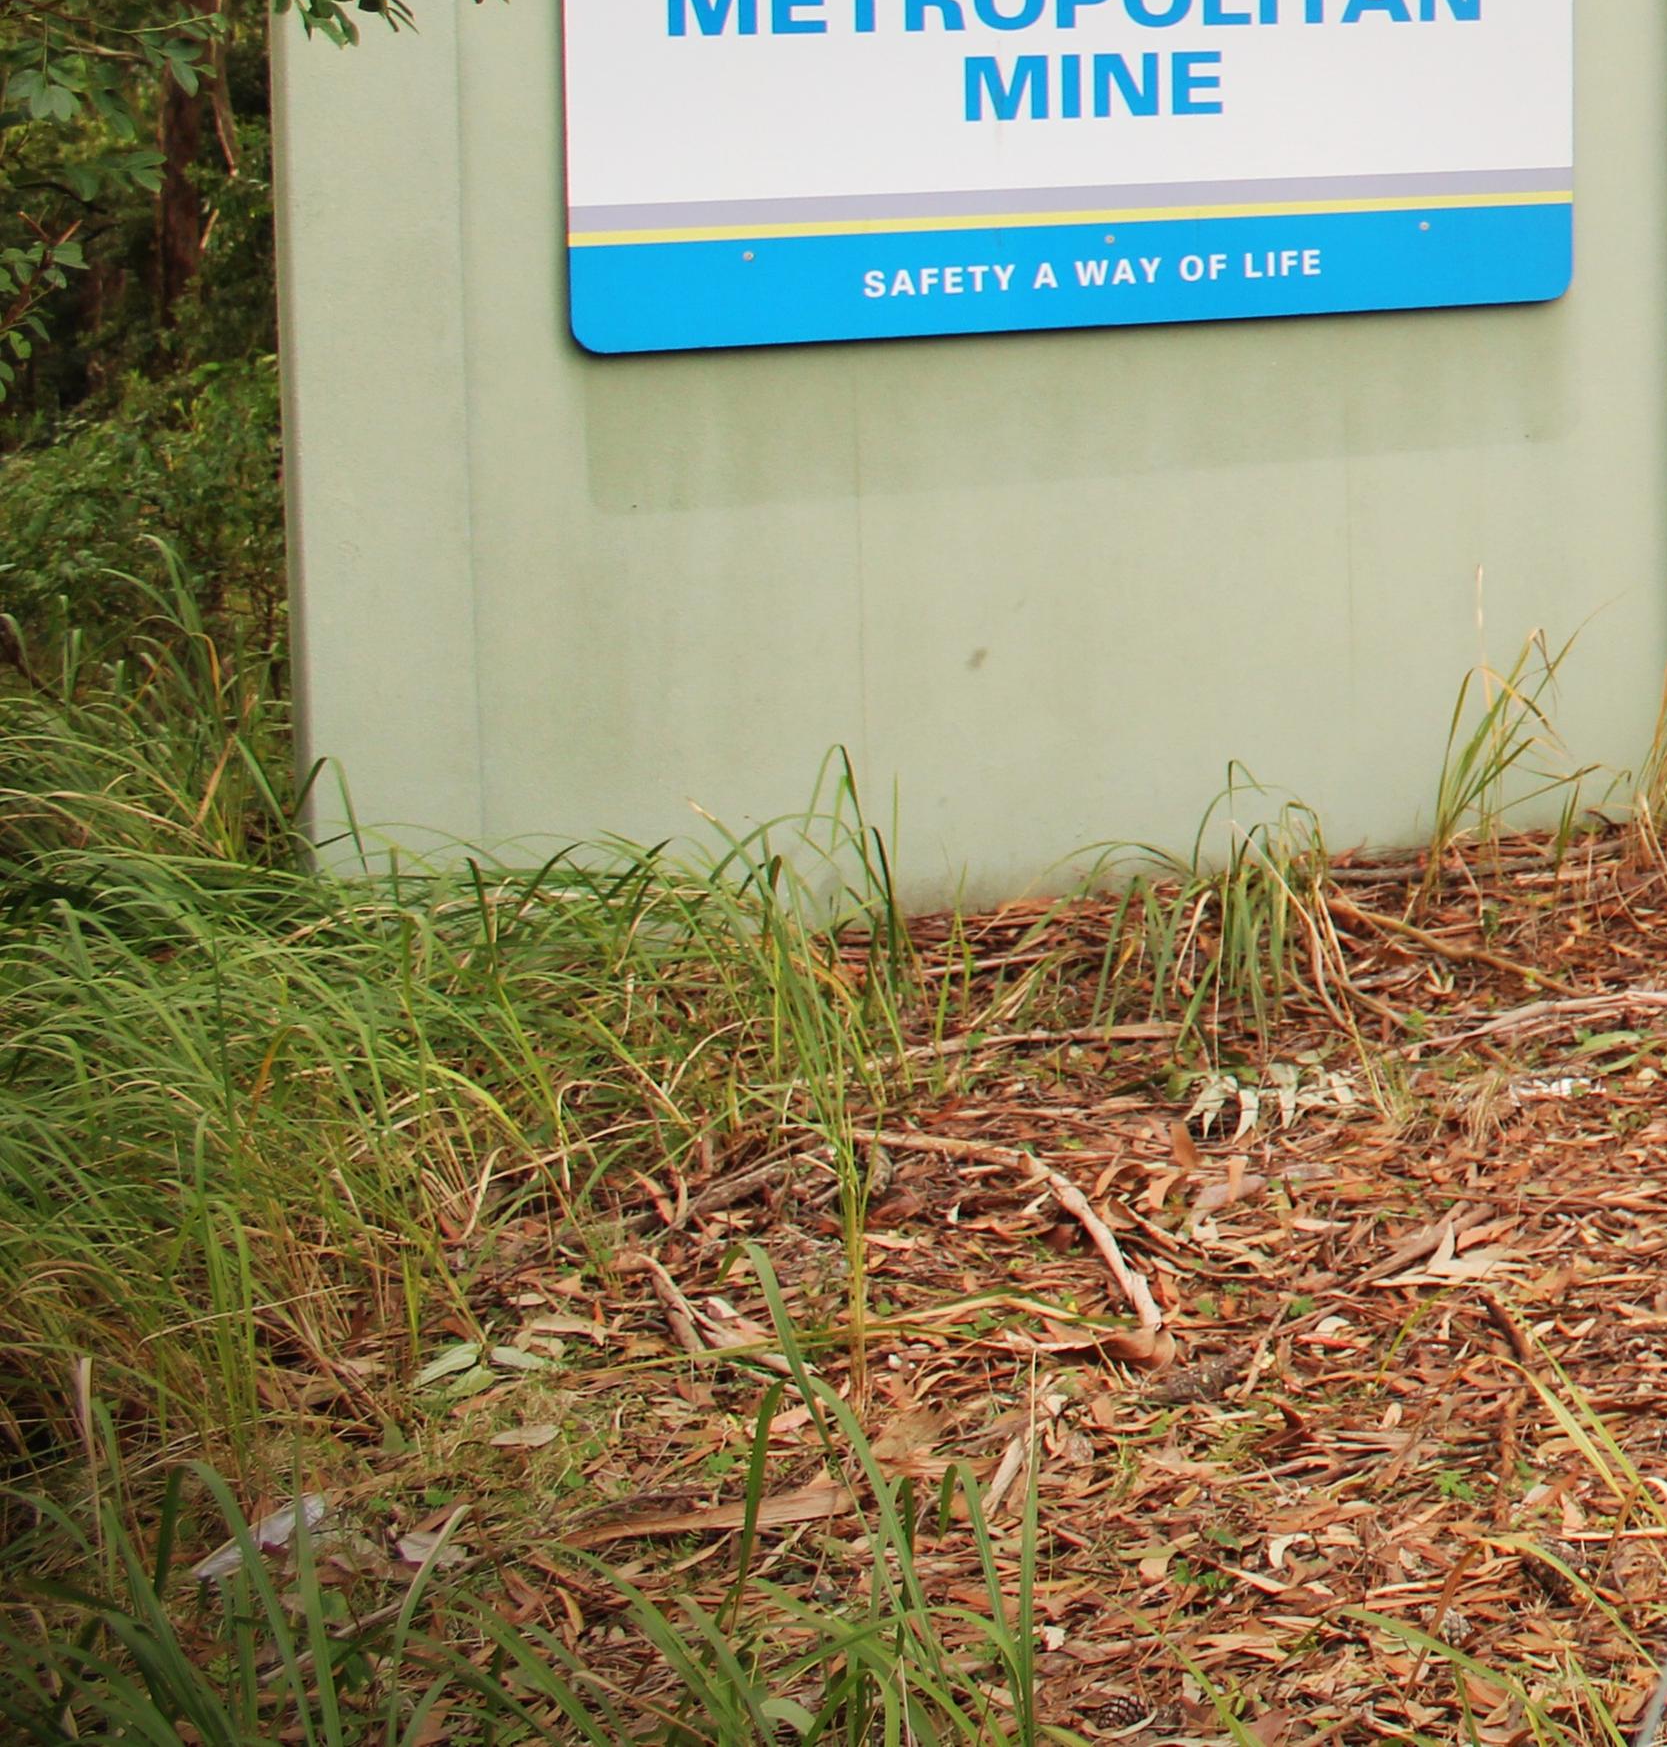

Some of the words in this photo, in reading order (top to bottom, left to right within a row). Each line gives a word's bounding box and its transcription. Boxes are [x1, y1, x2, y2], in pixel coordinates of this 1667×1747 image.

[963, 51, 1222, 122] MINE
[863, 264, 1014, 298] SAFETY
[1033, 262, 1057, 289] A
[1074, 257, 1160, 287] WAY
[1179, 254, 1226, 282] OF
[1244, 249, 1320, 279] LIFE
